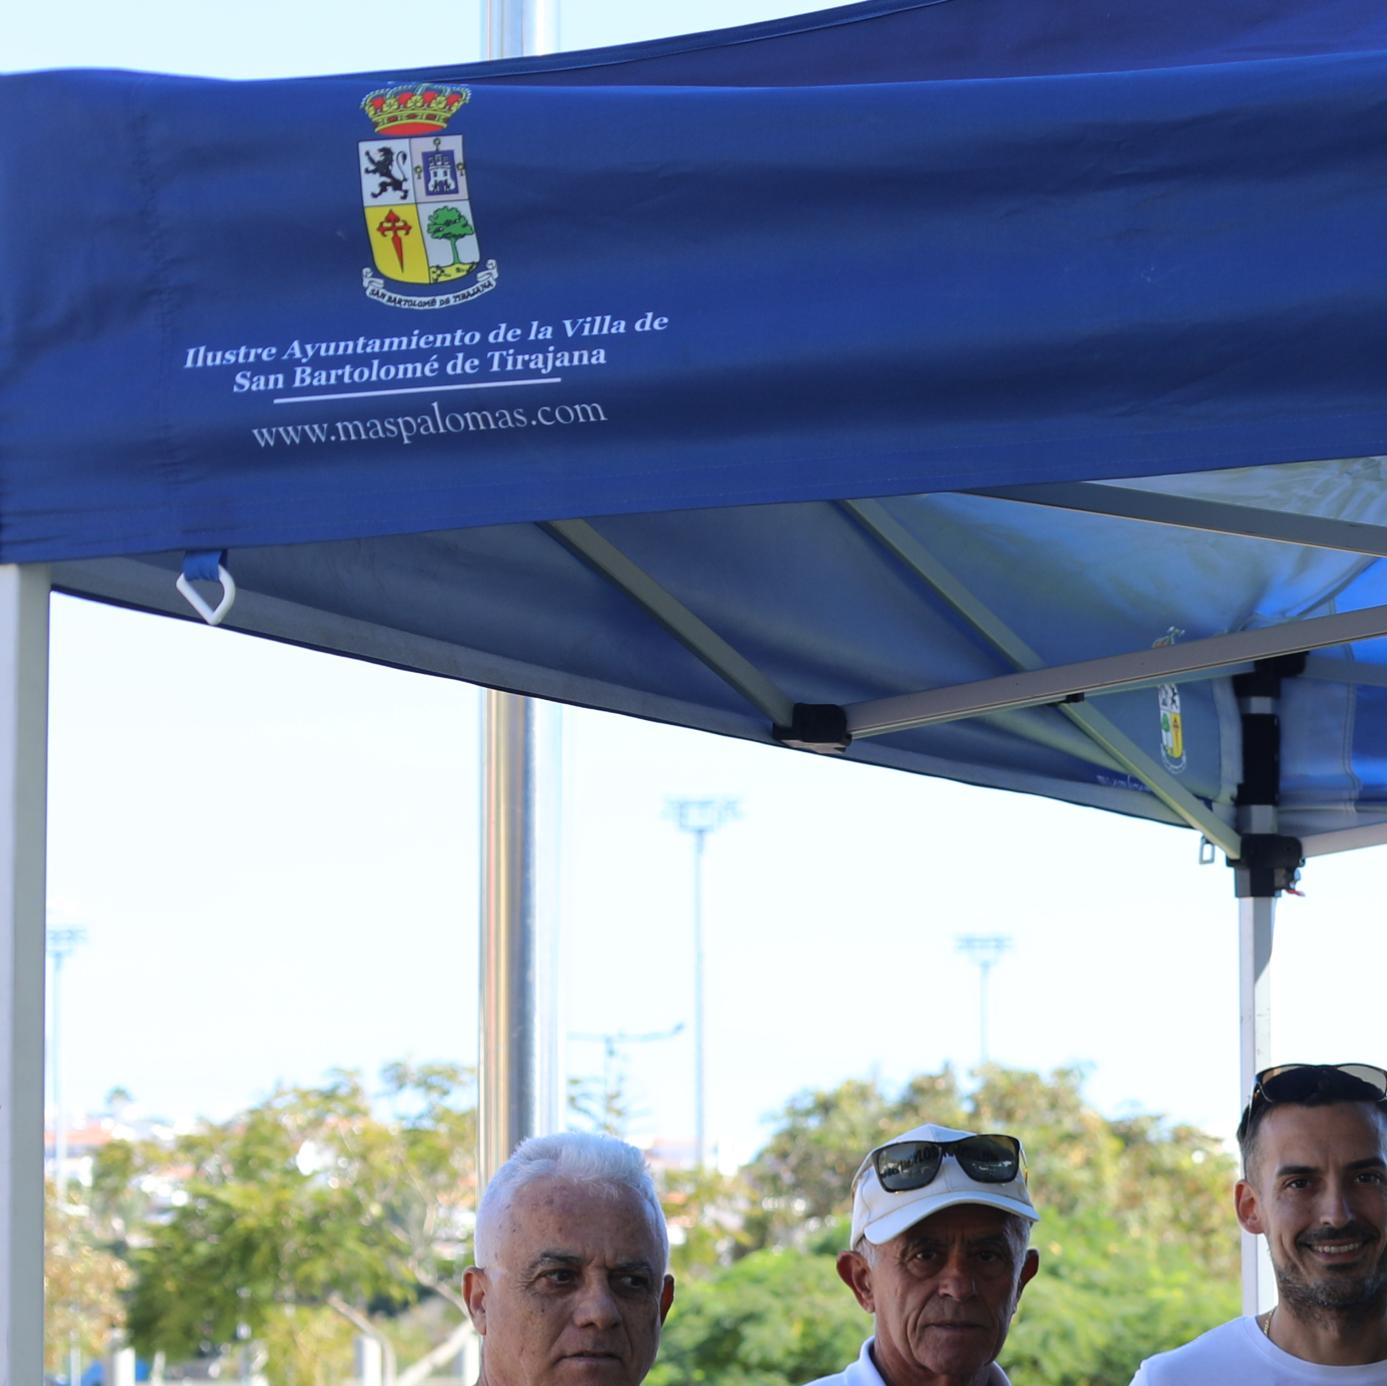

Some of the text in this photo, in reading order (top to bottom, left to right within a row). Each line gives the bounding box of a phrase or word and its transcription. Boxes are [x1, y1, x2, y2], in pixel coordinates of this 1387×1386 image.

[184, 312, 669, 369] Ilustre Ayuntamiento de la Villa de
[233, 346, 607, 393] San Bartolomé de Tirajana
[252, 401, 608, 449] www.maspalomas.com
